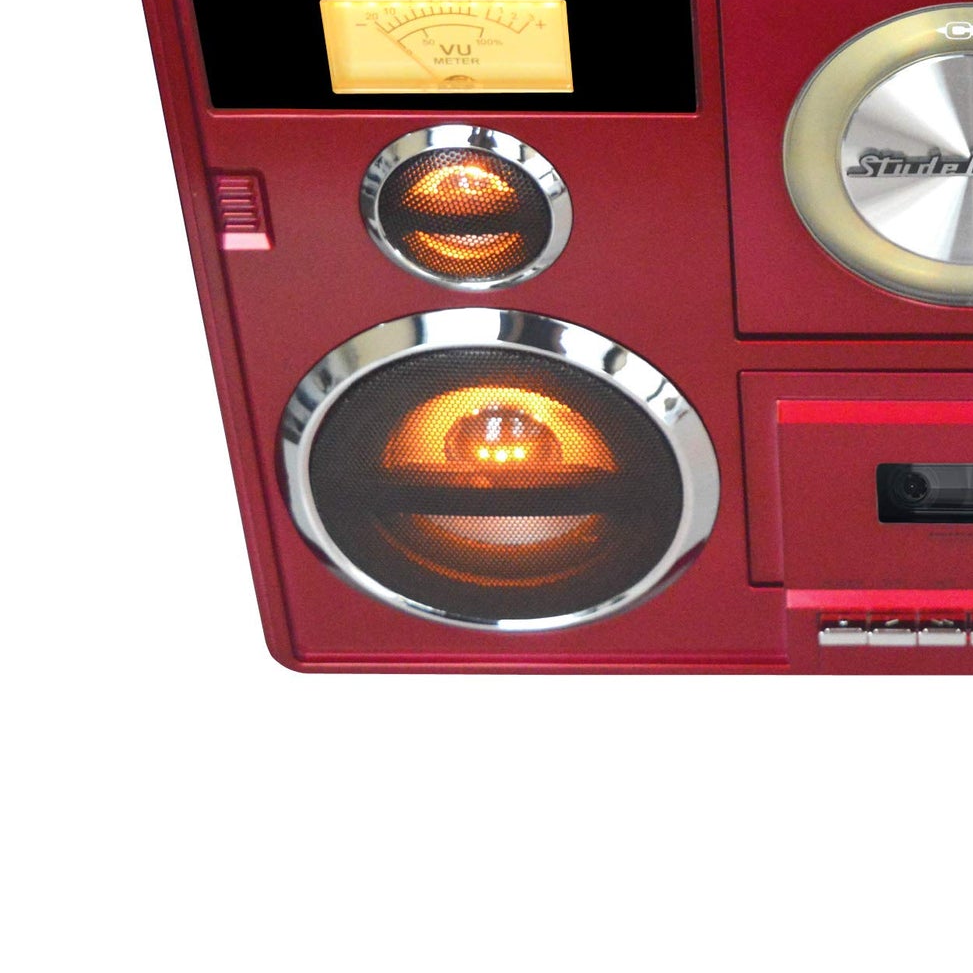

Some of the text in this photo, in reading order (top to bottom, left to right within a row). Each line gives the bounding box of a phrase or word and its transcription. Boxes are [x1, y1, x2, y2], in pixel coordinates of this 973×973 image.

[365, 7, 396, 21] 20 10
[422, 38, 435, 46] 50
[440, 43, 472, 56] VU
[434, 57, 480, 65] METER
